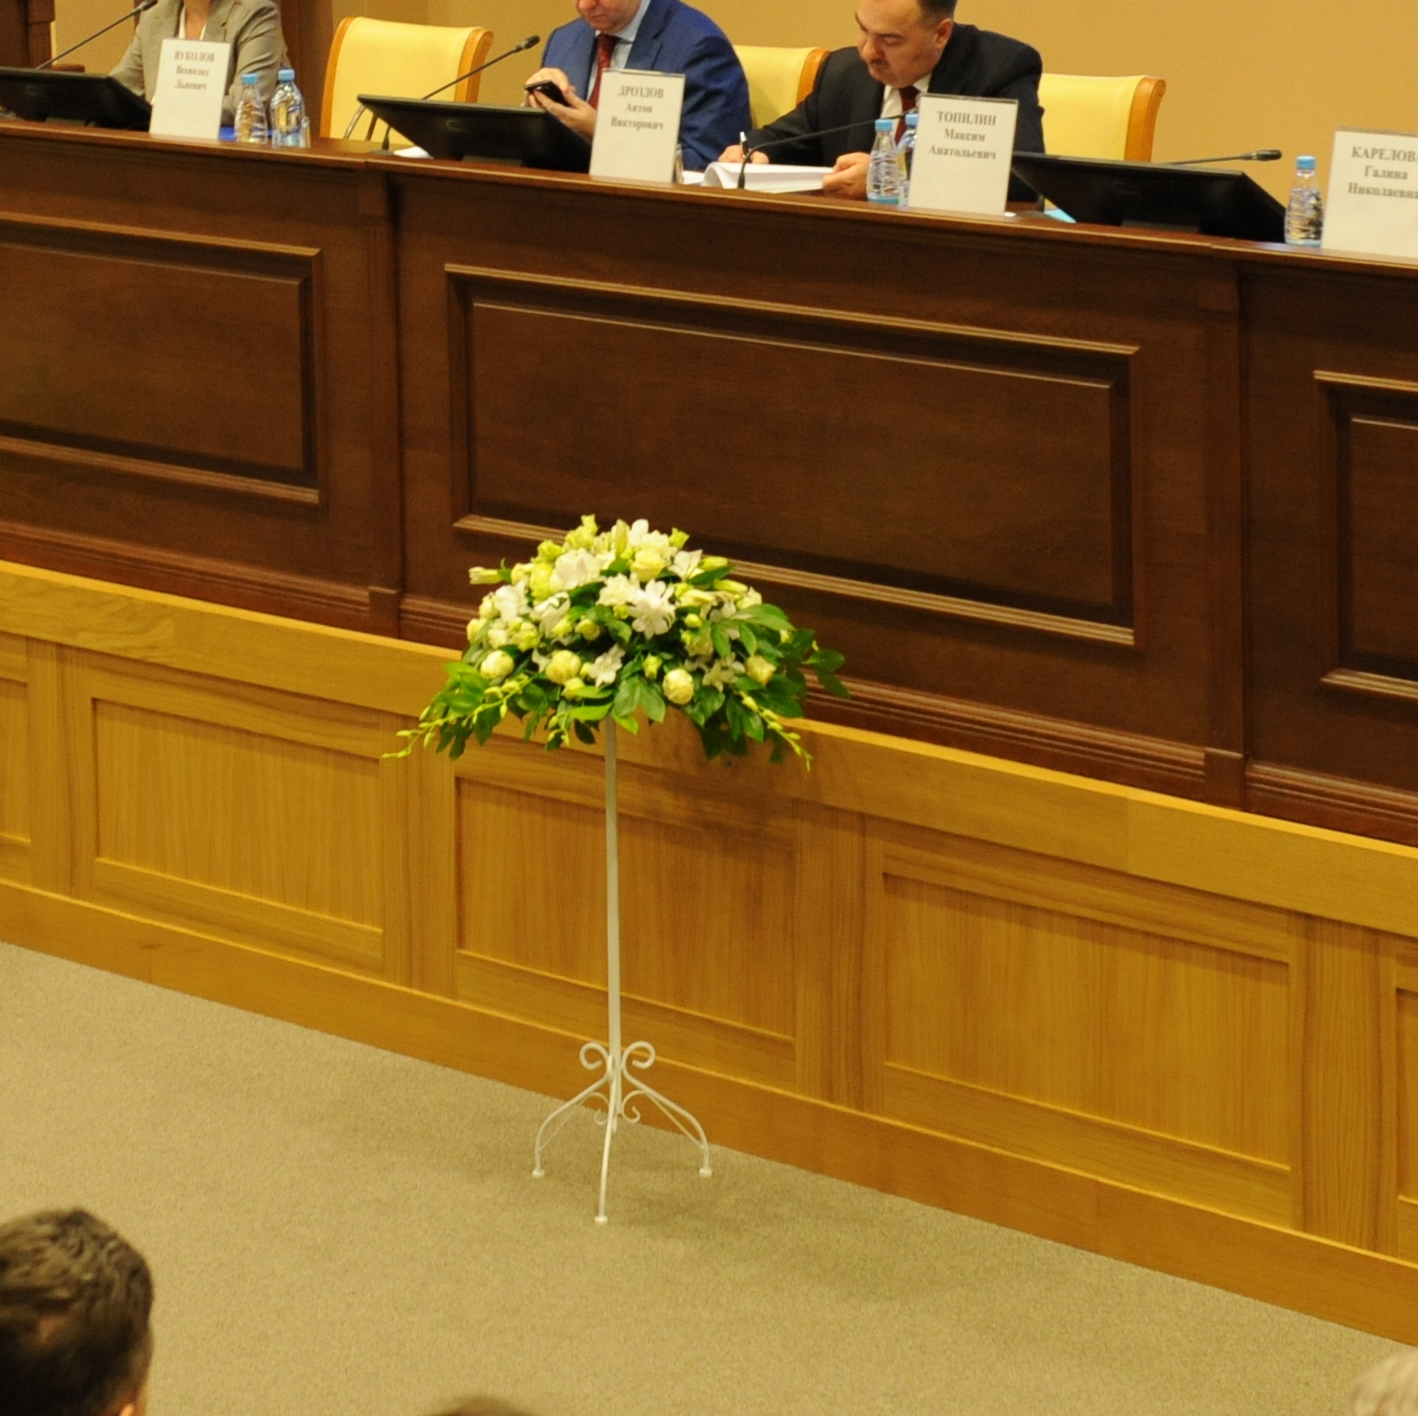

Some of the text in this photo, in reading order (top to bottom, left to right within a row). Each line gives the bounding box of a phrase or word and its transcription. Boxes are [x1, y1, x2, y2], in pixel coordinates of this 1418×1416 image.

[617, 85, 664, 99] ДРОЗДОВ
[624, 102, 653, 113] Антон
[610, 116, 664, 131] Викторович
[937, 110, 997, 126] ТОПИЛИН
[943, 127, 986, 142] Максим
[928, 144, 997, 160] Анатольевич
[1363, 164, 1408, 180] Галина
